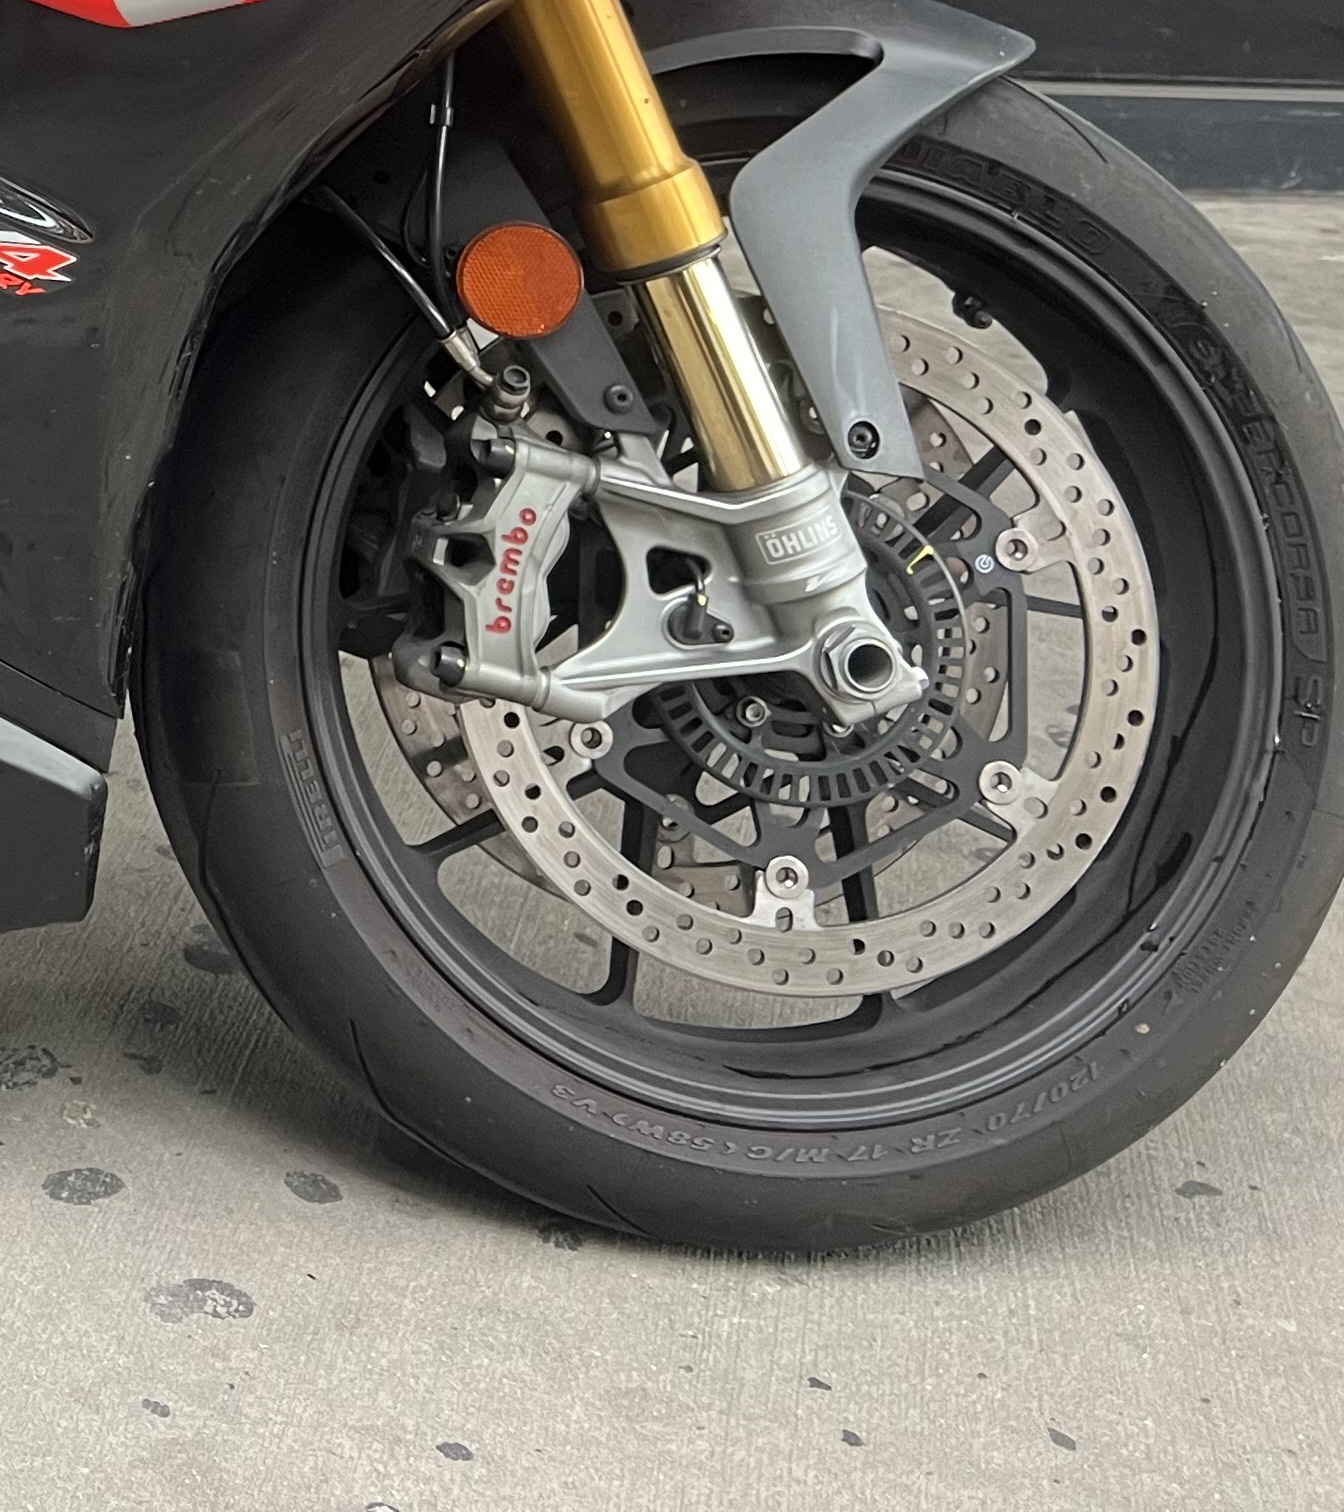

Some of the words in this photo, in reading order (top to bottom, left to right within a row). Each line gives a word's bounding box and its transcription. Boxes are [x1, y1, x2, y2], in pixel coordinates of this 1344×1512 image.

[763, 514, 839, 559] ÖHLINS
[485, 507, 538, 635] brembo
[279, 729, 348, 869] PIRELLI
[551, 1084, 598, 1120] V3
[988, 1061, 1100, 1132] 120/70
[611, 1112, 739, 1156] (58W)
[746, 1144, 831, 1164] M/C
[847, 1142, 889, 1163] 17
[909, 1126, 963, 1155] ZR
